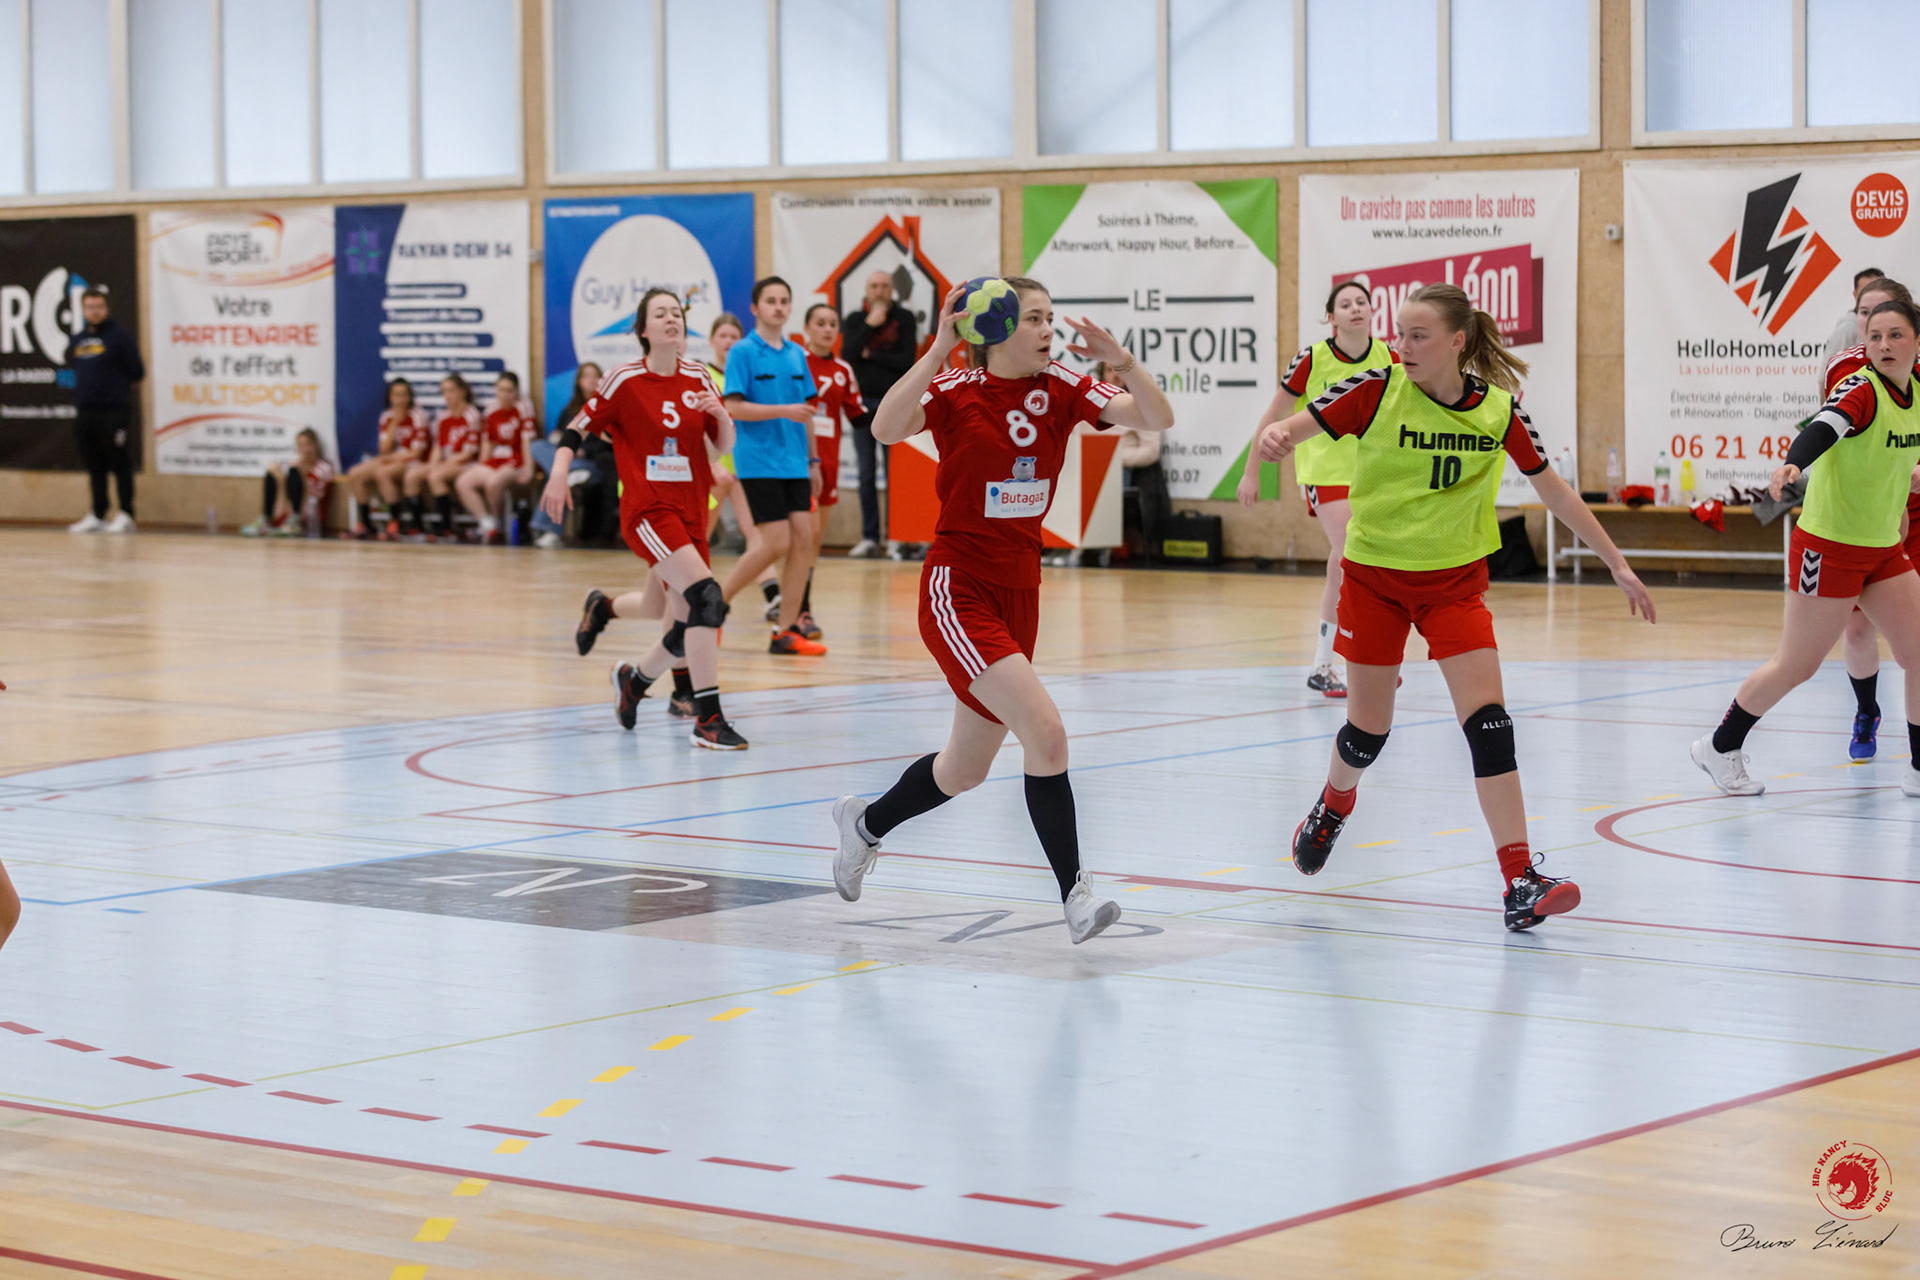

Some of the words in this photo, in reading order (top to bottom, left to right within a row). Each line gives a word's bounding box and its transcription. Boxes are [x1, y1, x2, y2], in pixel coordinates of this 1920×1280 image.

[781, 199, 854, 209] Construisons
[859, 197, 912, 207] ensemble
[918, 196, 948, 207] votre
[953, 196, 993, 207] avenir
[1341, 196, 1356, 220] Un
[1360, 195, 1401, 220] caviste
[1405, 197, 1425, 224] pas
[1429, 195, 1472, 219] comme
[1476, 193, 1493, 218] les
[1497, 193, 1536, 217] autres
[1856, 190, 1905, 207] DEVIS
[1098, 214, 1141, 227] Soirées
[1145, 214, 1151, 226] à
[1156, 213, 1199, 227] Thème,
[1856, 208, 1904, 220] GRATUIT
[1373, 225, 1503, 239] www.lacavedeleon.fr
[1052, 239, 1113, 252] Afterwork,
[1118, 238, 1156, 253] Happy
[1160, 238, 1191, 251] Hour,
[583, 278, 624, 309] Guy
[1134, 289, 1160, 311] LE
[215, 296, 272, 316] Votre
[171, 325, 319, 346] PARTENAIRE
[191, 357, 213, 375] de
[222, 355, 297, 376] l'effort
[1680, 365, 1691, 376] La
[1697, 364, 1750, 376] solution
[1756, 366, 1786, 377] pour
[1792, 365, 1818, 376] votr
[173, 383, 319, 406] MULTISPORT
[819, 375, 833, 398] 7
[1671, 390, 1722, 403] Électricité
[1725, 392, 1772, 405] générale
[1783, 392, 1819, 405] Dépan
[662, 401, 681, 429] 5
[1671, 409, 1680, 418] et
[1684, 407, 1743, 418] Rénovation
[1006, 409, 1038, 447] 8
[1161, 442, 1222, 455] nile.com
[1671, 435, 1703, 458] 06
[1715, 435, 1746, 460] 21
[1429, 455, 1462, 490] 10
[1001, 492, 1044, 506] Butagaz
